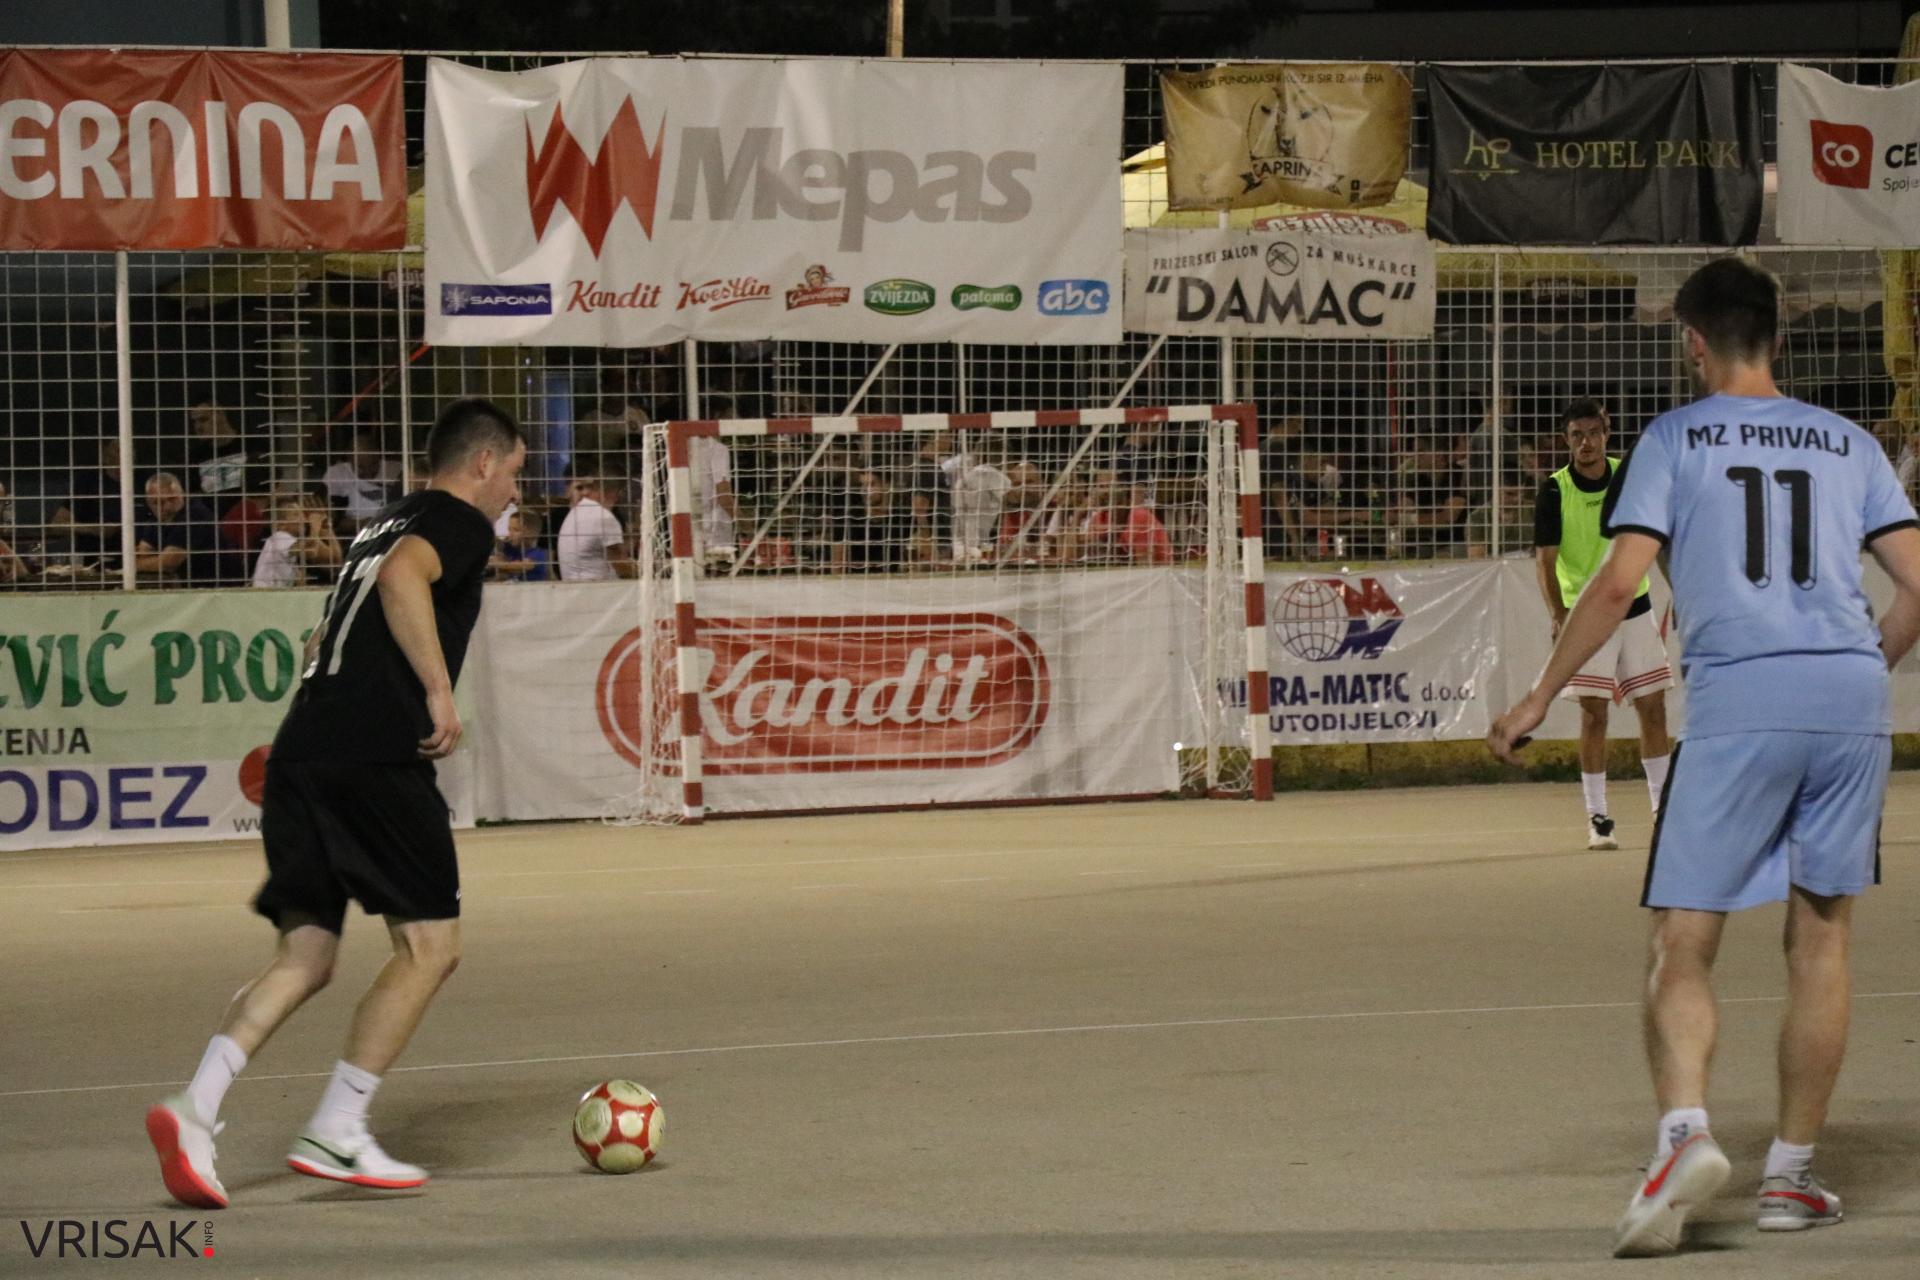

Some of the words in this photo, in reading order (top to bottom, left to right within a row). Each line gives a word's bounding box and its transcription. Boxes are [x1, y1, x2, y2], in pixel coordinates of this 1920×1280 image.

[0, 99, 383, 201] ERNINA
[1535, 141, 1646, 168] HOTEL
[1655, 140, 1740, 168] PARK
[1885, 142, 1920, 169] CE
[669, 126, 1037, 252] Mepas
[1153, 251, 1217, 270] FRIZERSKI
[1221, 245, 1259, 261] SALON
[1307, 246, 1324, 259] ZA
[1333, 250, 1417, 277] MUŠKARCE
[470, 294, 549, 305] SAPONIA
[566, 280, 662, 312] Kandit
[676, 277, 771, 311] Koestlin
[870, 289, 930, 306] ZVIJEZDA
[959, 290, 1014, 305] paloma
[1043, 282, 1104, 311] abc
[1687, 424, 1729, 450] MZ
[1740, 424, 1850, 457] PRIVALJ
[1726, 466, 1817, 591] 11
[0, 609, 128, 709] VIĆ
[151, 628, 313, 705] PRO
[661, 647, 989, 745] Kandit
[1268, 710, 1437, 732] UTODIJELOVI
[0, 727, 91, 756] ENJA
